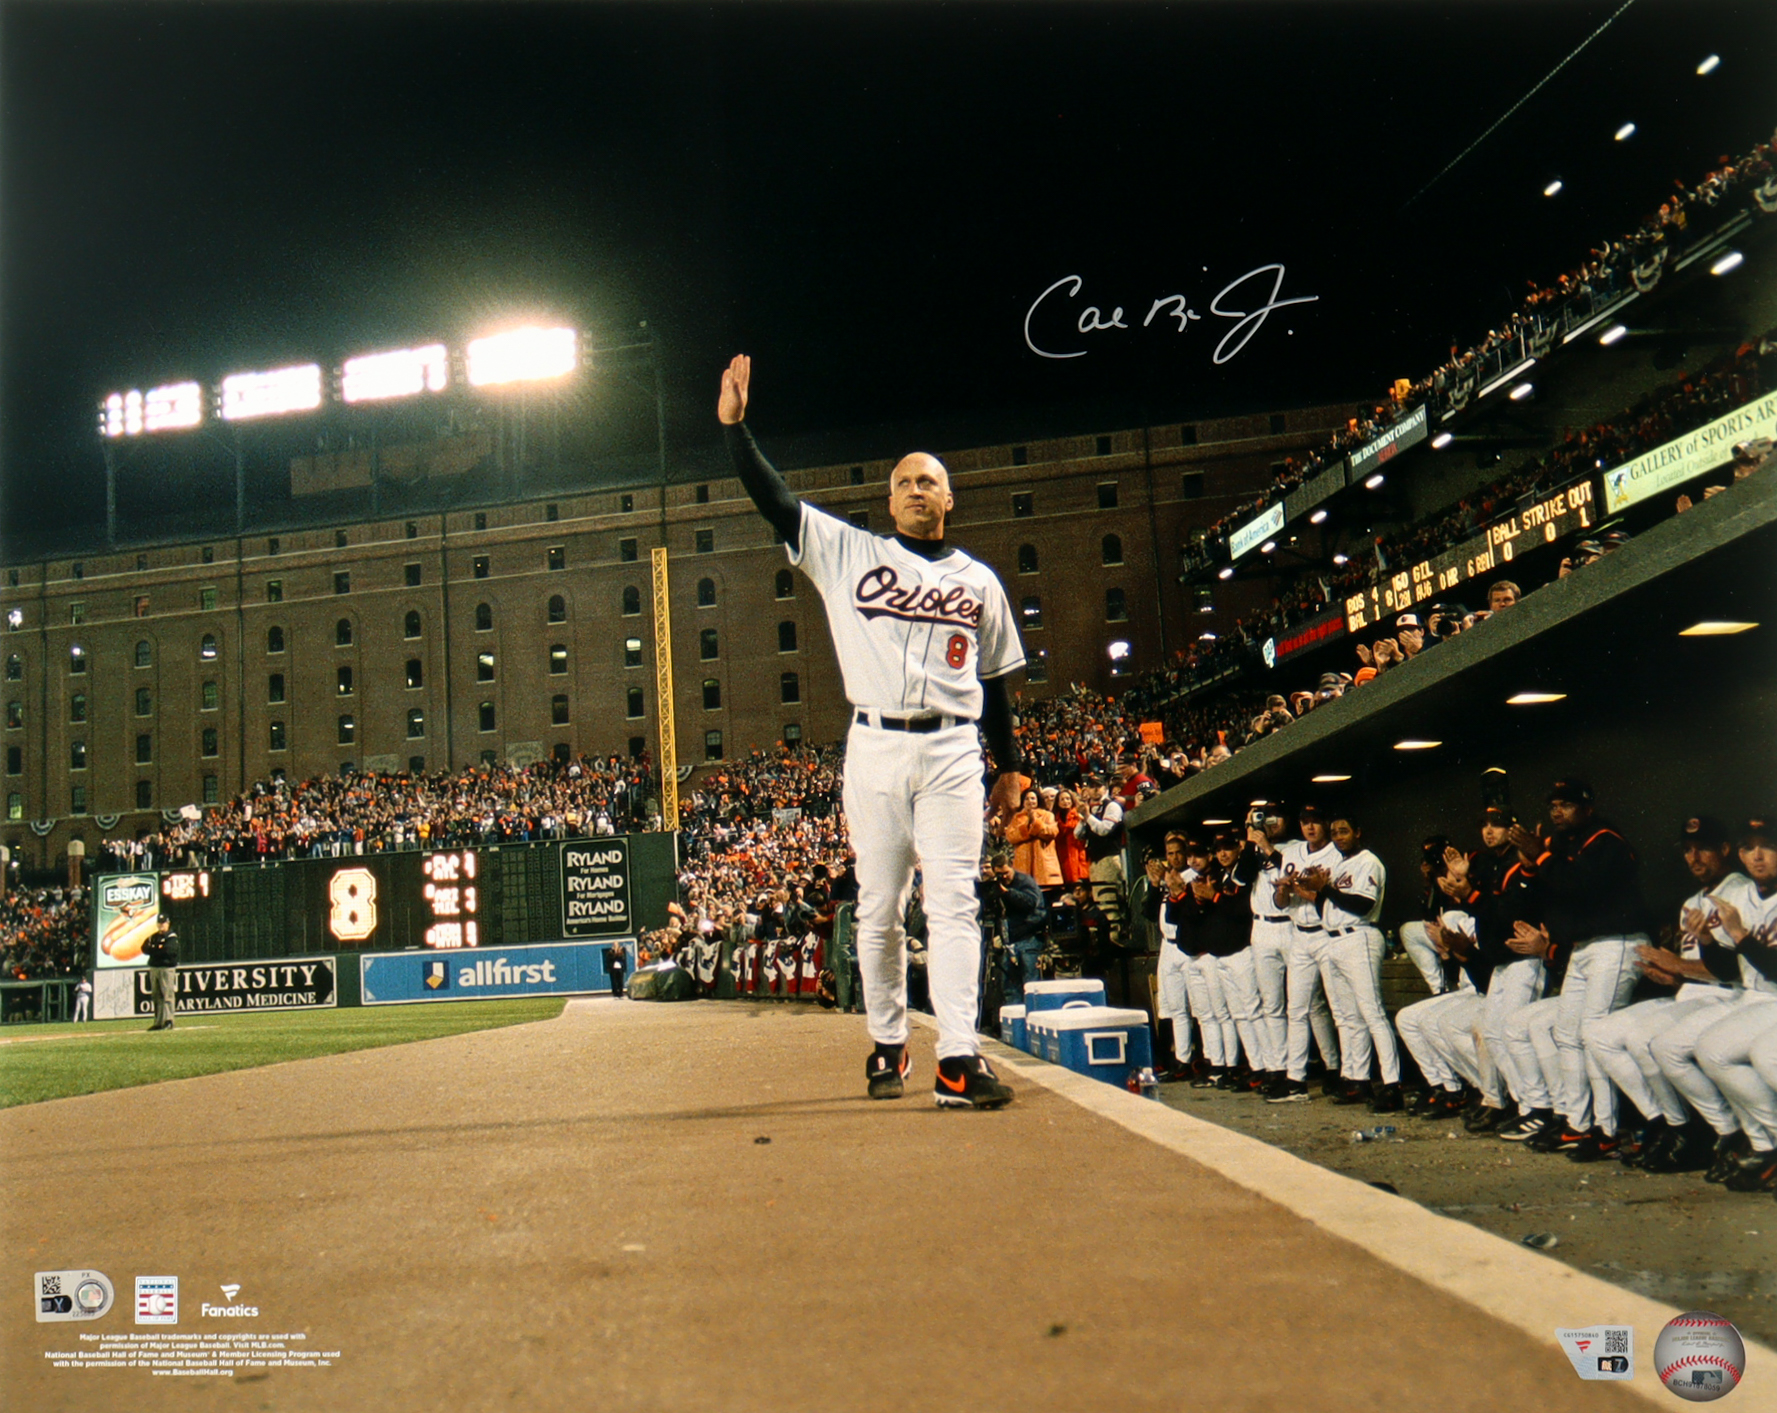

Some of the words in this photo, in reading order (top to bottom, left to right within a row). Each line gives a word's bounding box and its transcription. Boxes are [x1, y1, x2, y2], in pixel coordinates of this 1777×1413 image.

[1362, 429, 1395, 460] DOCUMENT
[1394, 409, 1426, 439] COMPANY
[1630, 442, 1684, 480] GALLERY
[1686, 435, 1699, 455] of
[1701, 409, 1754, 449] SPORTS
[1492, 518, 1521, 545] BALL
[1522, 493, 1567, 530] STRIKE
[1568, 480, 1592, 509] OUT
[1503, 541, 1513, 561] 0
[1545, 522, 1556, 542] 0
[1579, 507, 1590, 527] 1
[855, 564, 983, 623] Orioles
[1346, 592, 1365, 615] BOS
[1371, 586, 1379, 602] 4
[1348, 612, 1368, 633] BAL
[1373, 604, 1380, 621] 1
[945, 633, 969, 670] 8
[567, 850, 623, 868] RYLAND
[107, 886, 151, 902] ESSKAY
[568, 875, 623, 892] RYLAND
[329, 867, 377, 940] 8
[569, 900, 625, 917] RYLAND
[138, 964, 317, 995] UIVERSITY
[458, 958, 556, 987] allfirst
[176, 996, 242, 1011] ARYLAND
[247, 992, 317, 1007] MEDICINE
